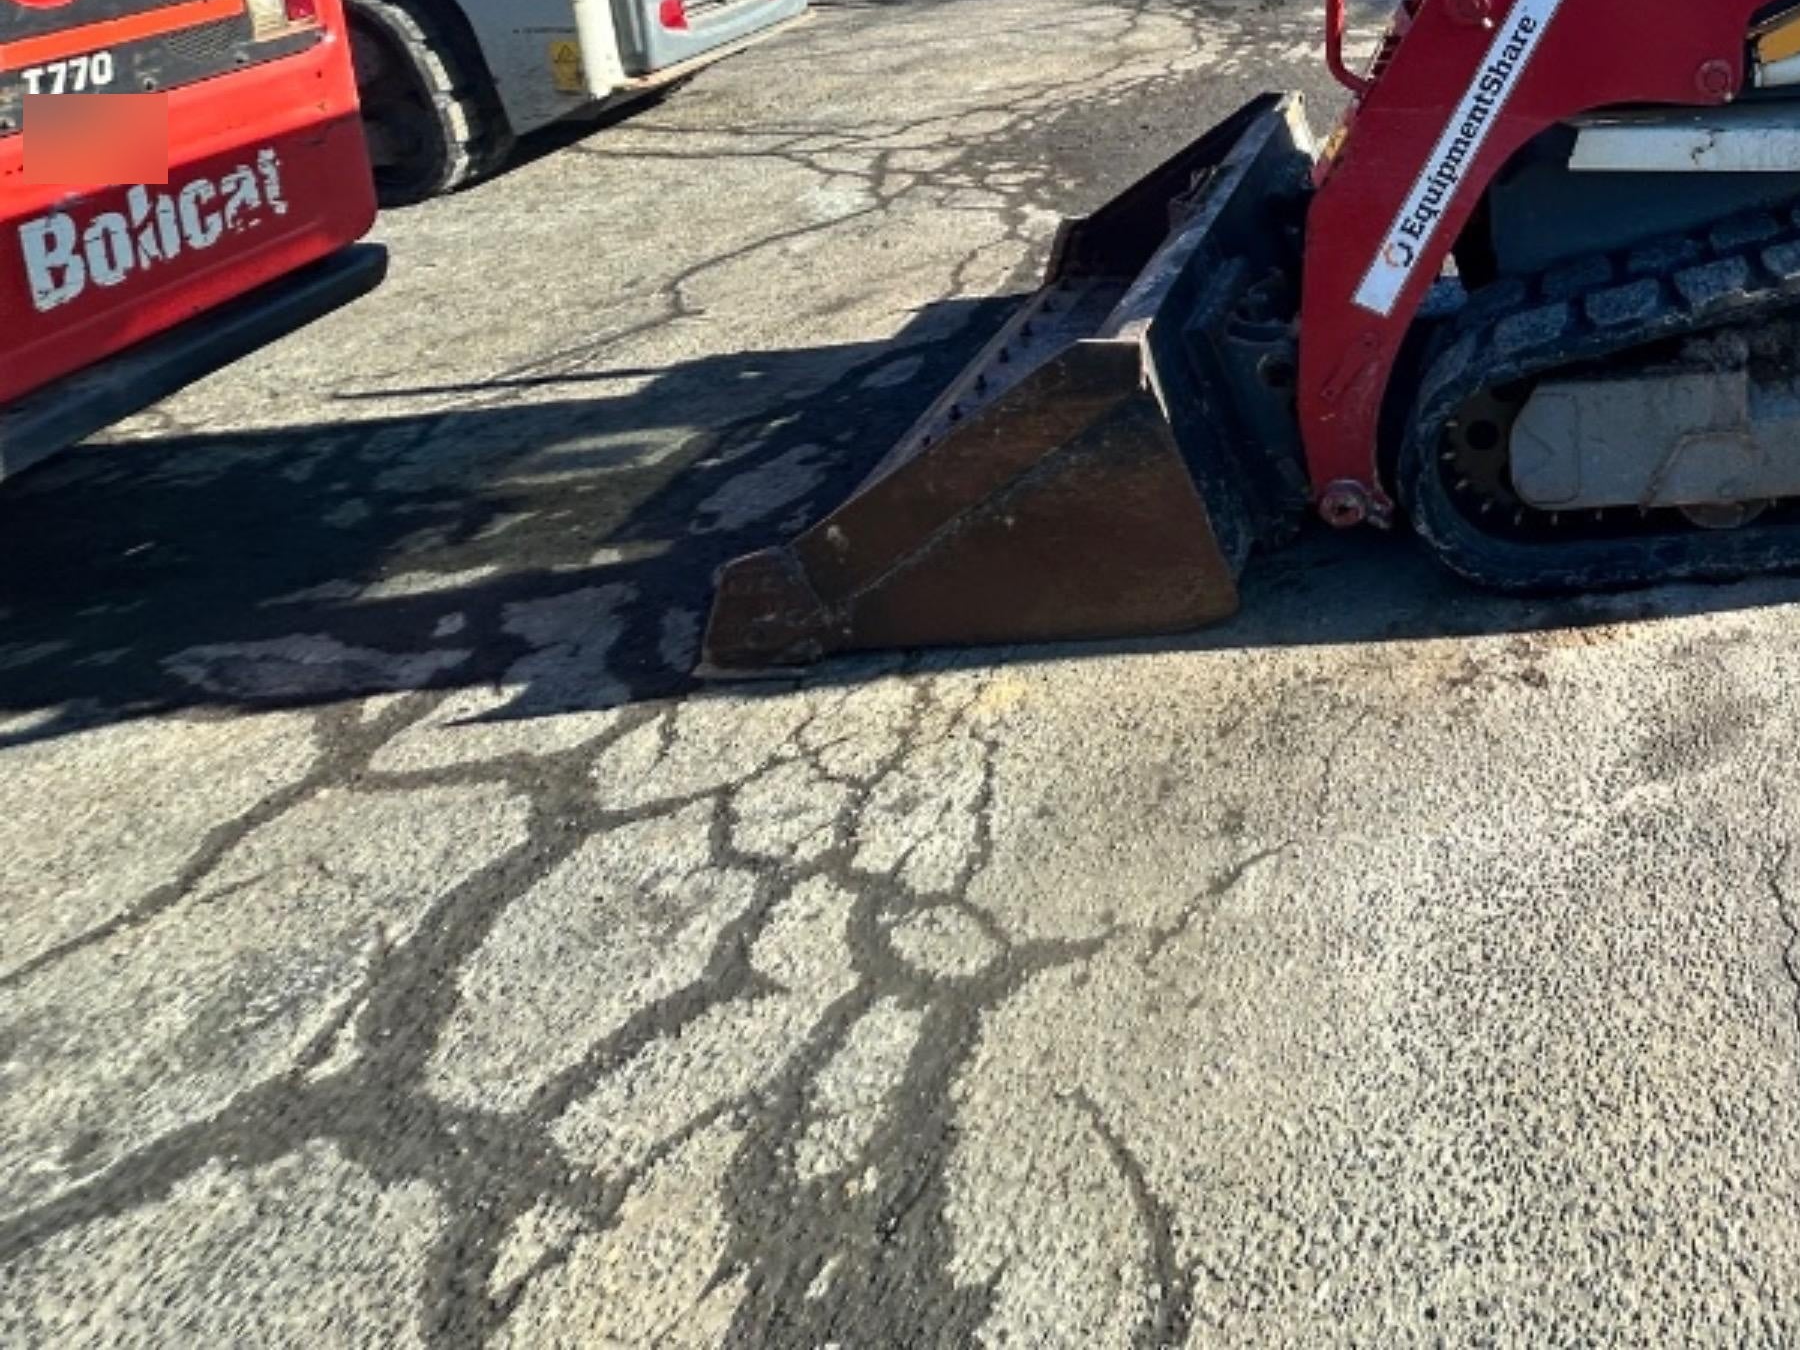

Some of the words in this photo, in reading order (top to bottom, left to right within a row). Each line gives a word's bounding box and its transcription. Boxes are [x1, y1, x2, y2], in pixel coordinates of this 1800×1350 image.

[21, 51, 114, 96] T770
[1401, 14, 1538, 241] EquipmentShare
[18, 147, 289, 313] Bobcat
